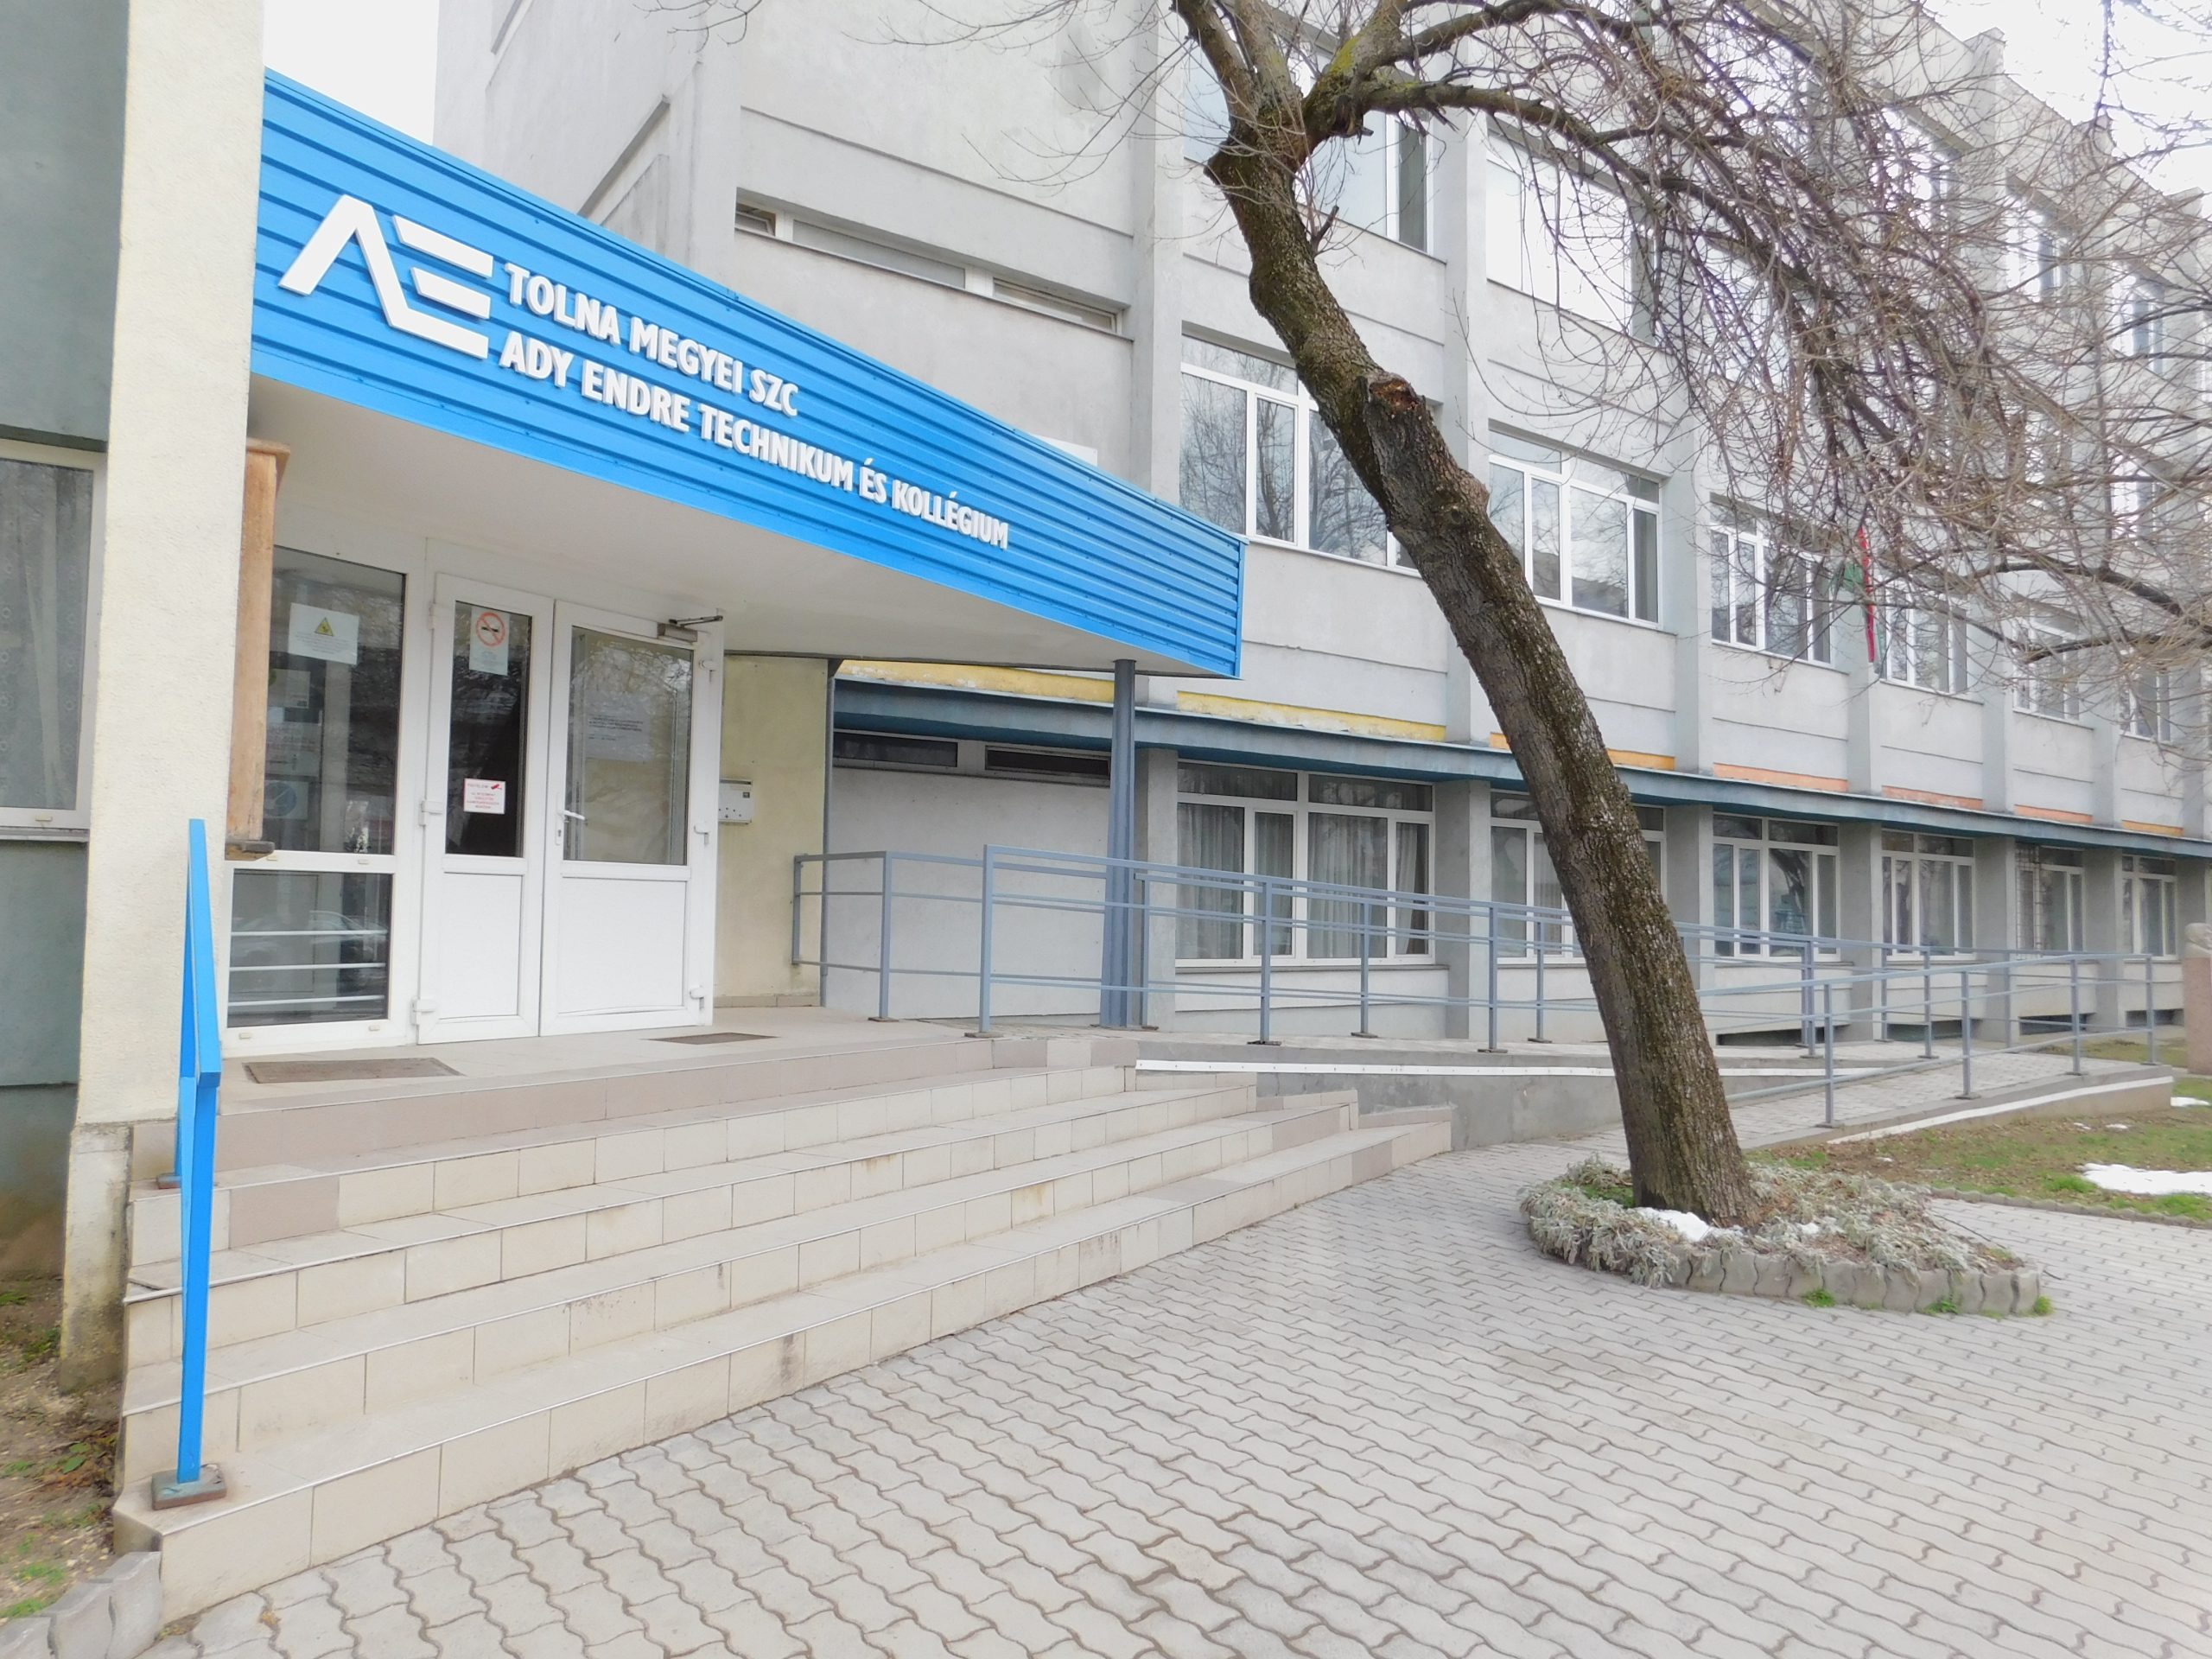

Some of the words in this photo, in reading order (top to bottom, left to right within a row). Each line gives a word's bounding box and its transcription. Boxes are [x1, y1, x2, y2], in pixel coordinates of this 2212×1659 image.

[504, 263, 621, 345] TOLNA
[629, 316, 743, 393] MEGYEI
[749, 369, 798, 416] SZC
[499, 331, 574, 388] ADY
[582, 359, 691, 432] ENDRE
[699, 404, 854, 492] TECHNIKUM
[859, 458, 887, 504] ÉS
[892, 491, 1009, 550] KOLLÉGIUM
